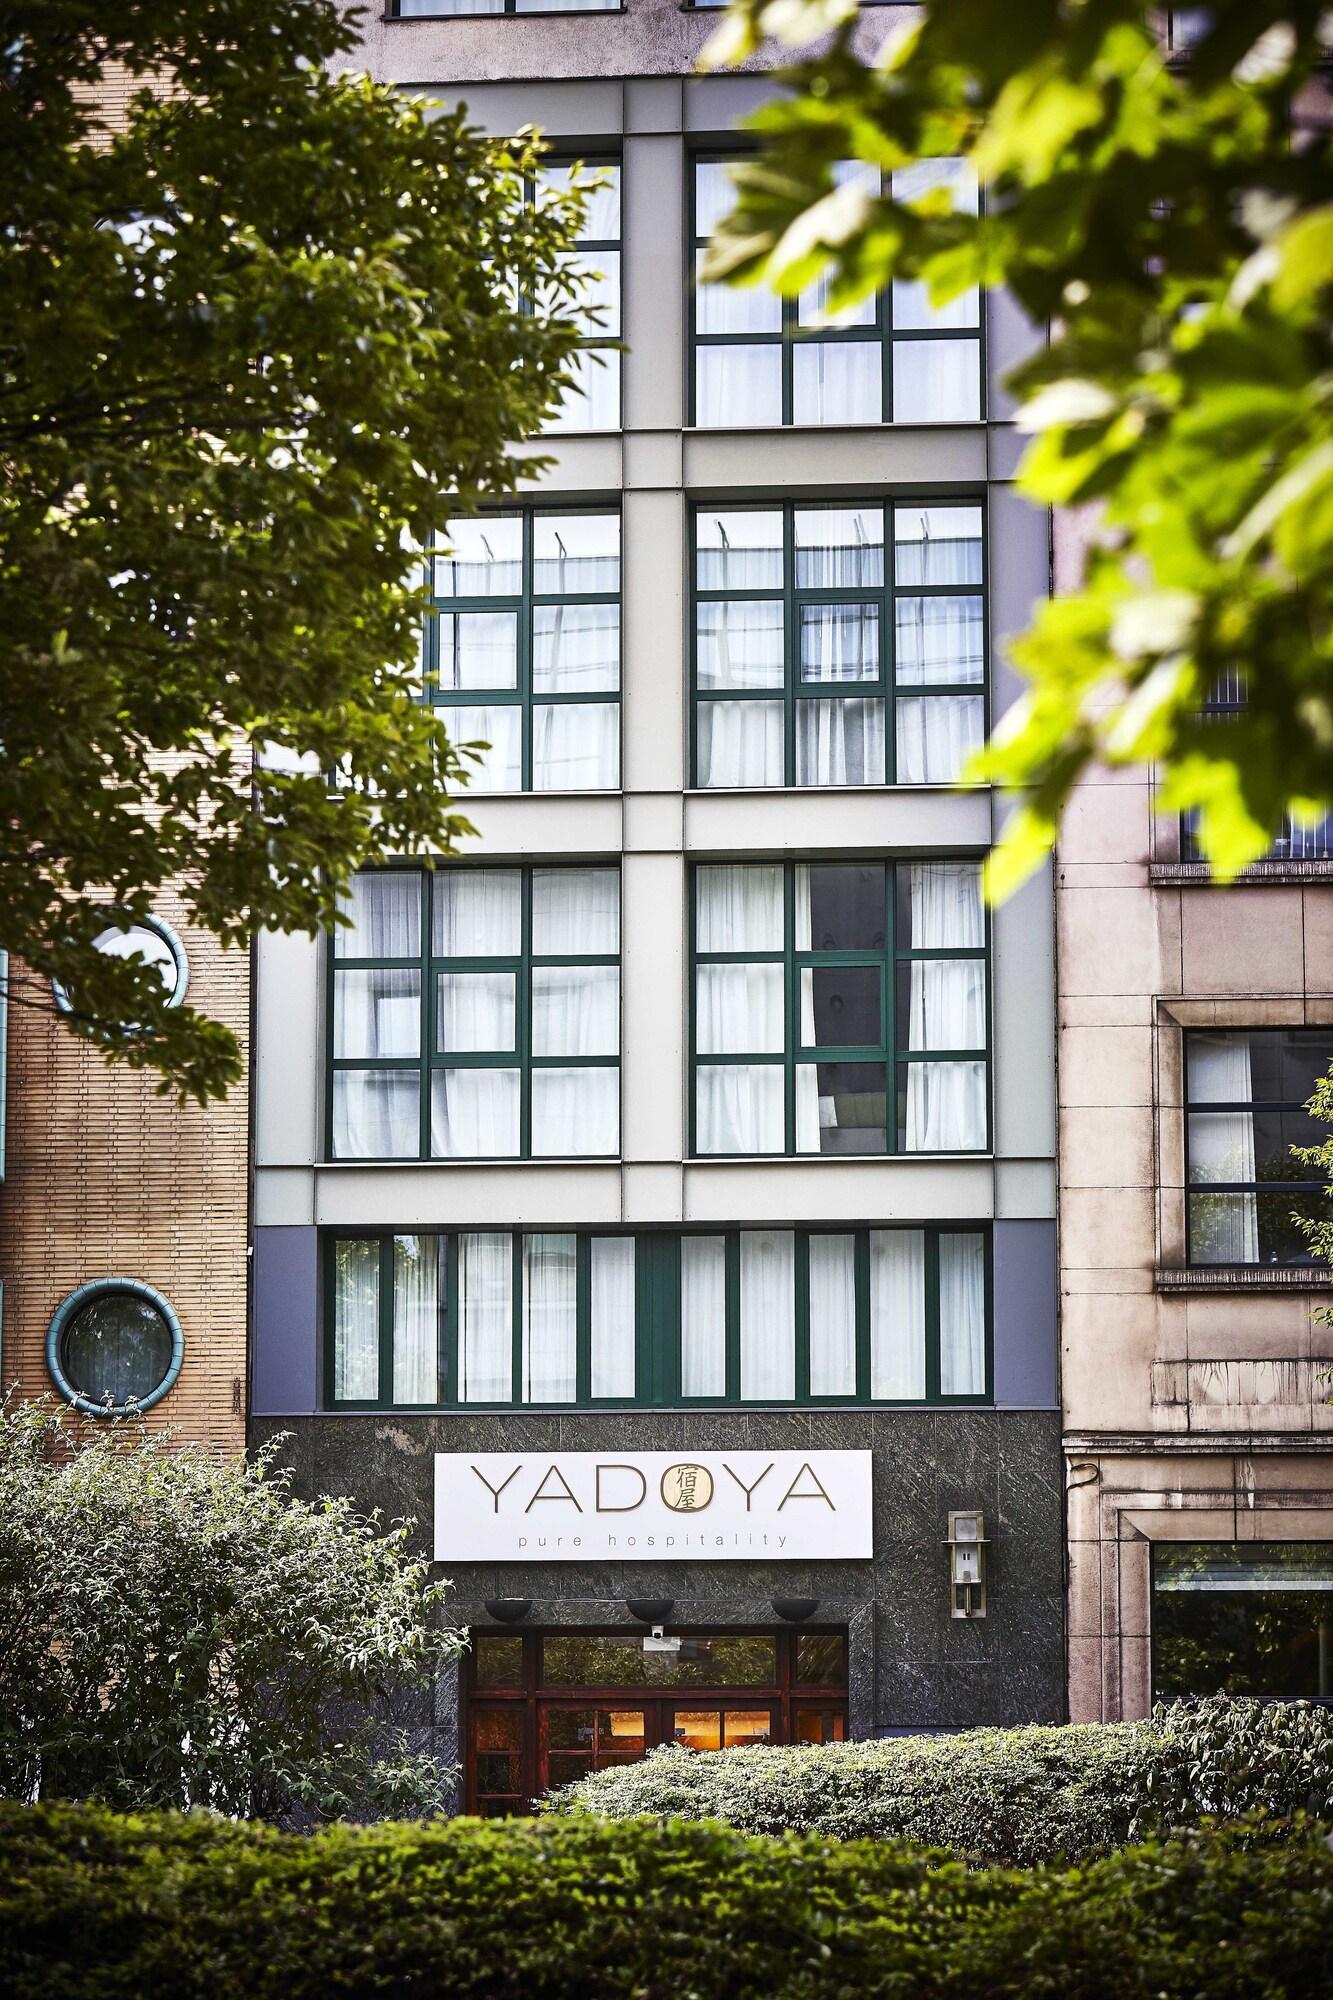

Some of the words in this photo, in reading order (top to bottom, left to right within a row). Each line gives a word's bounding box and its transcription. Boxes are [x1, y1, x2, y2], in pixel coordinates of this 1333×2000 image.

[471, 1464, 835, 1513] YADOYA
[675, 1465, 699, 1508] 宿屋
[519, 1537, 581, 1548] pure
[609, 1534, 786, 1547] hospitality
